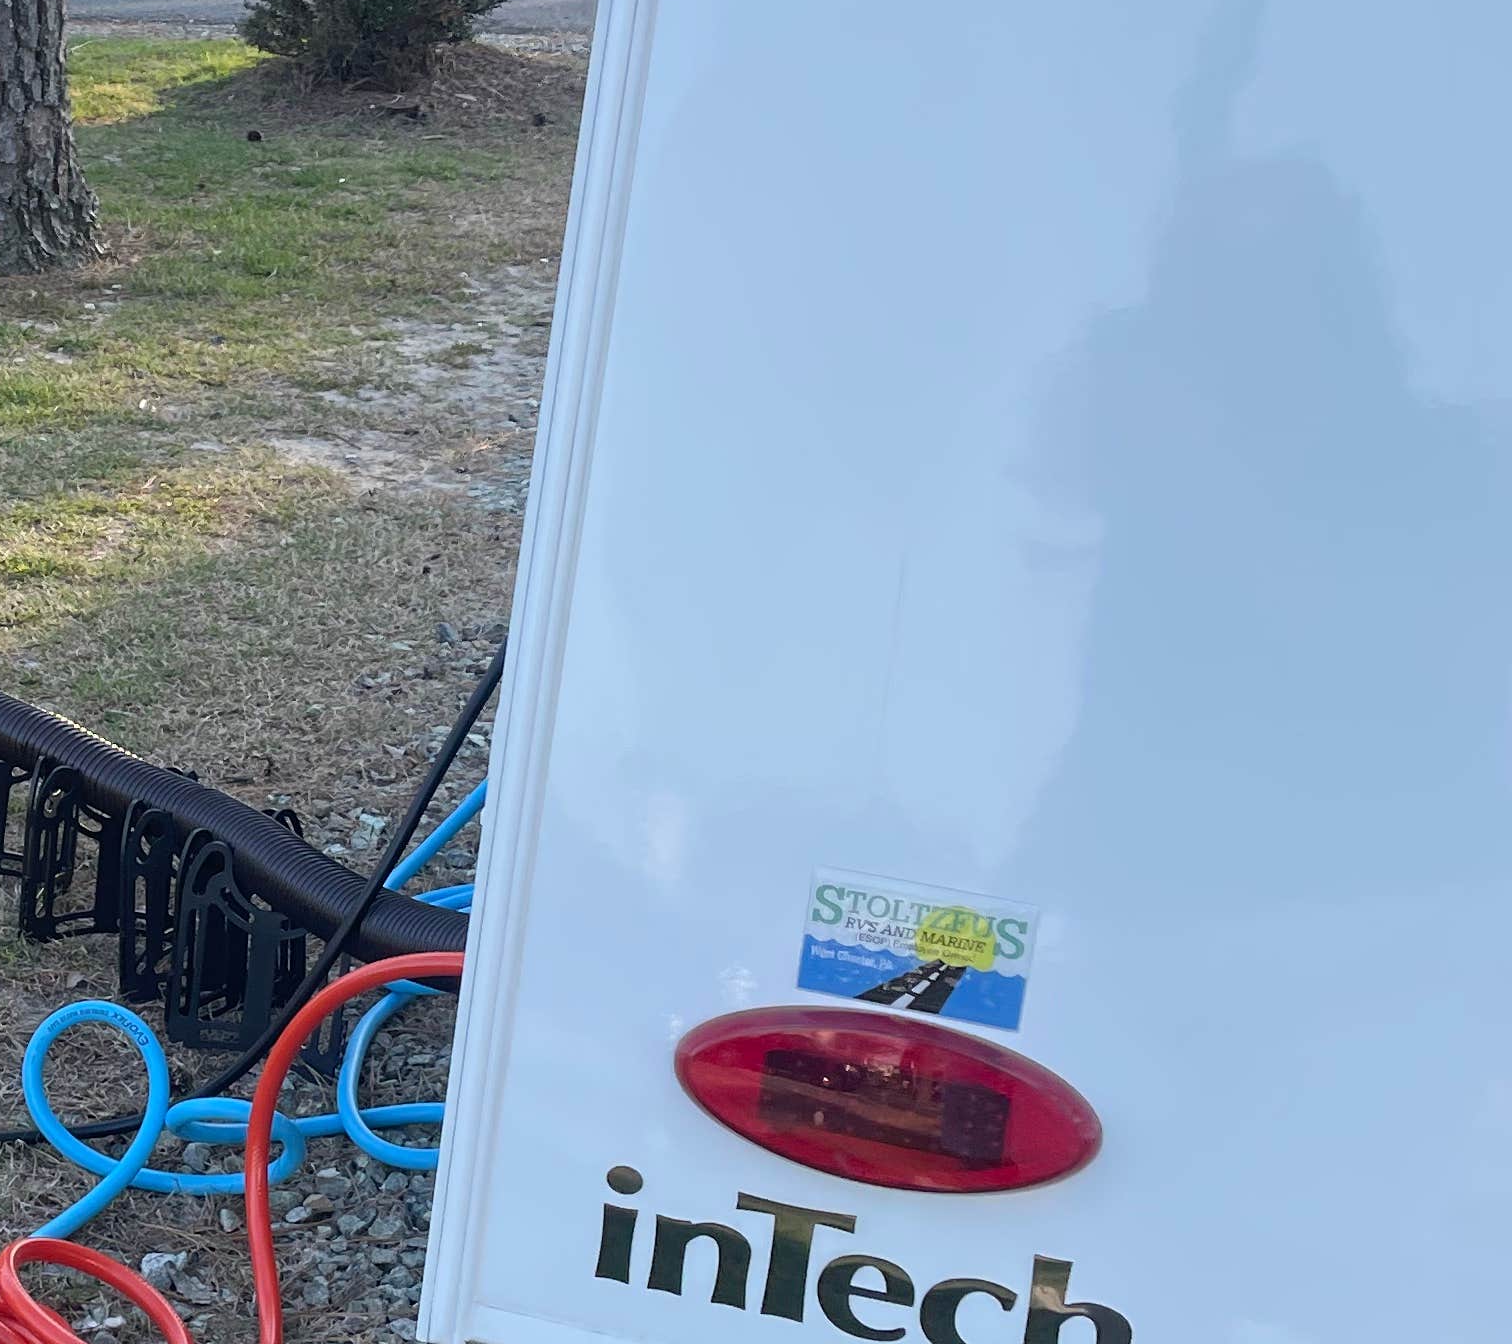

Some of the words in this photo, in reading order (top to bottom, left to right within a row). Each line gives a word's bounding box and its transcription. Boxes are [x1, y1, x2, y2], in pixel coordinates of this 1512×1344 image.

[812, 884, 1028, 959] STOLTZFUS
[845, 916, 878, 934] RV'S
[880, 922, 916, 940] AND
[920, 931, 986, 954] MARINE
